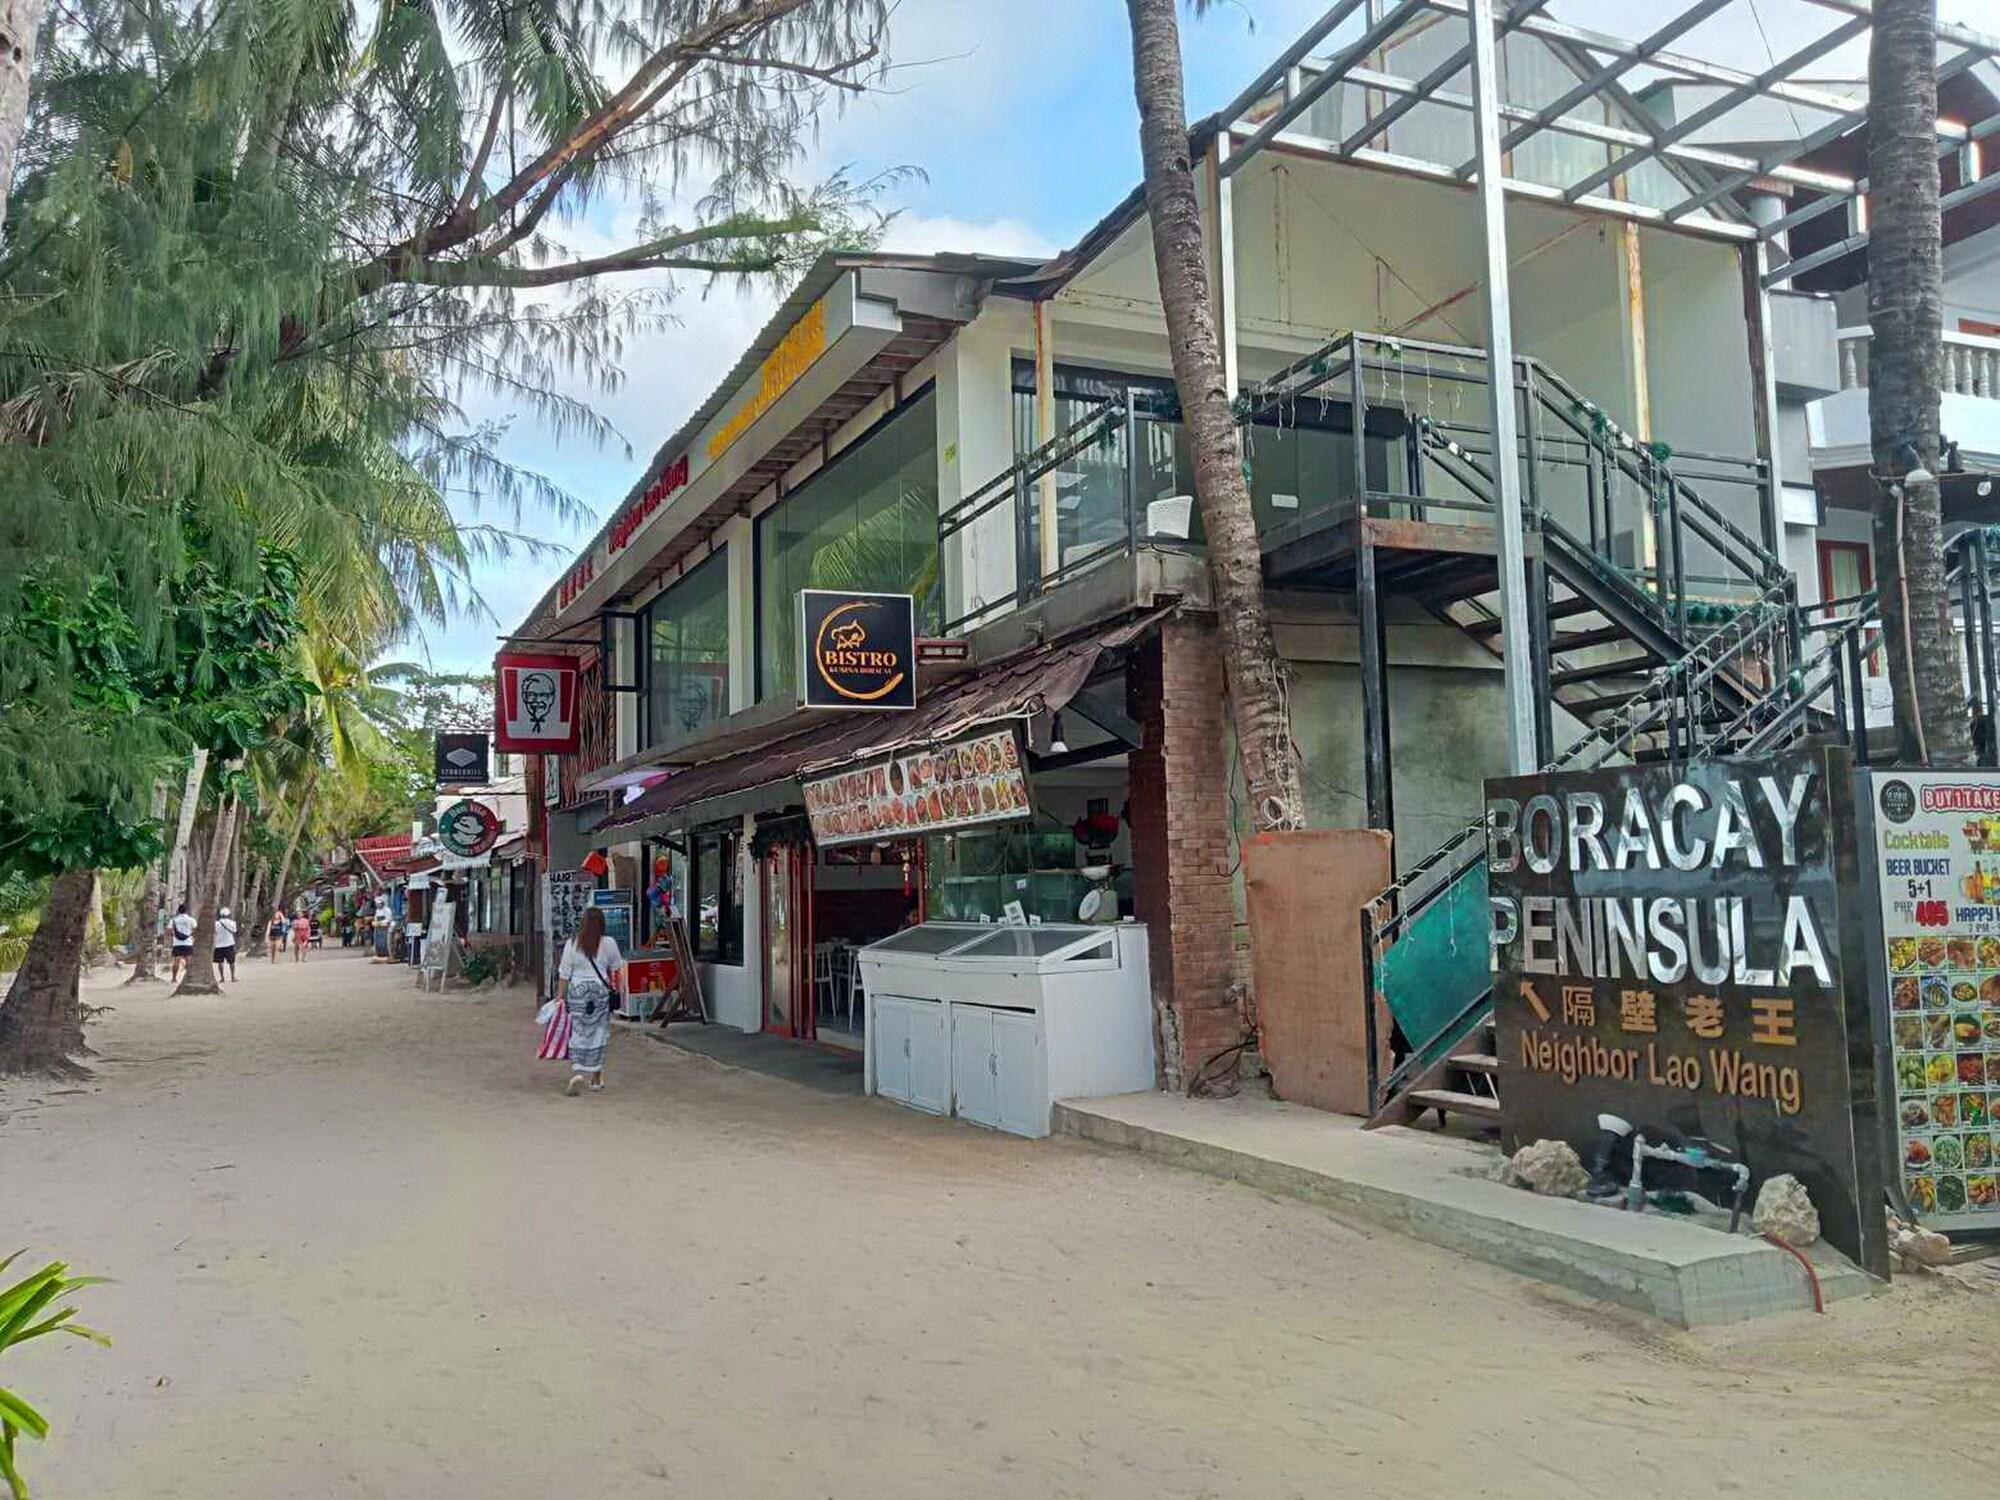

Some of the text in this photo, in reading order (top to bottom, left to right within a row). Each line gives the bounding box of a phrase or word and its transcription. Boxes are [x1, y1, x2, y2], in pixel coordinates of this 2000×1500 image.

[824, 650, 898, 668] BISTRO
[1925, 789, 1952, 808] BUY
[1489, 774, 1811, 874] BORACAY
[1884, 829, 1949, 850] Cocktails
[1886, 858, 1950, 876] BEER BUCKET
[1908, 879, 1932, 898] 5+1
[1956, 907, 1993, 922] HAPPY
[1489, 895, 1833, 988] PENINSULA
[1562, 985, 1797, 1046] 隔壁老王
[1520, 1029, 1800, 1114] Neighbor Lao Wang
